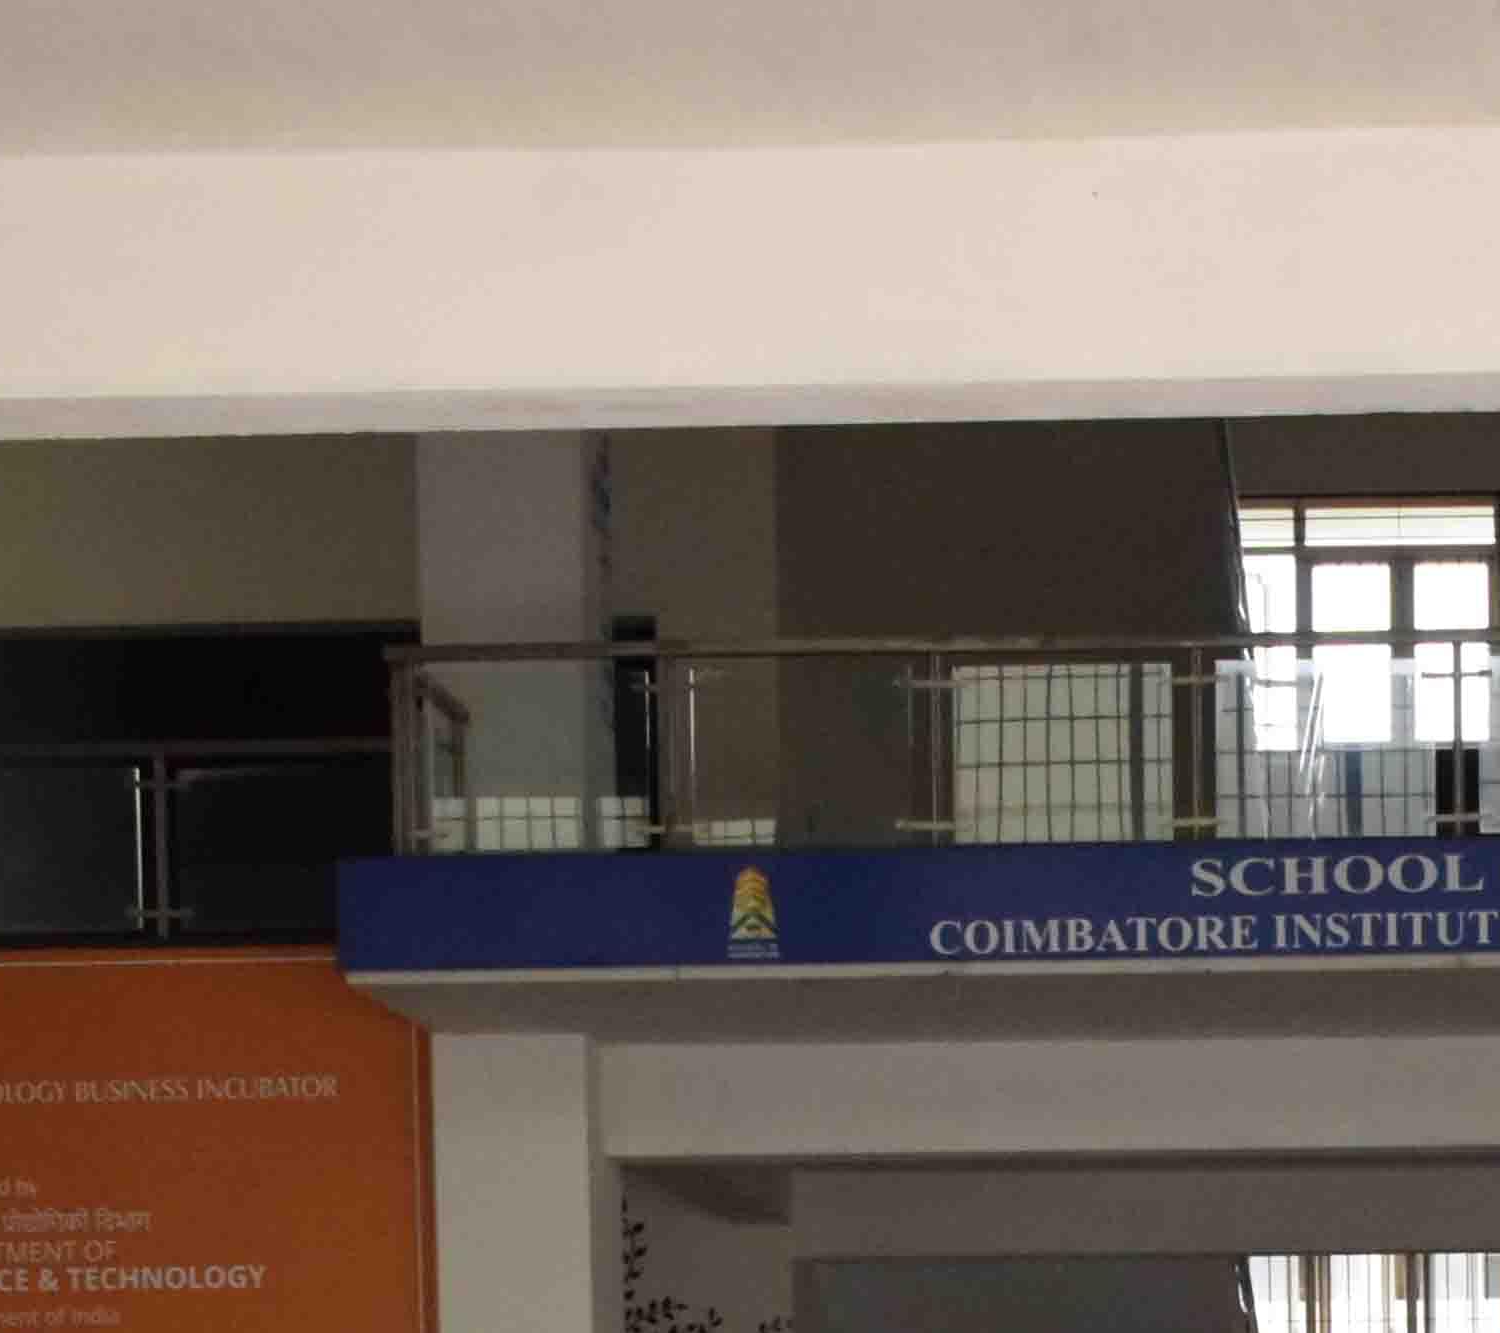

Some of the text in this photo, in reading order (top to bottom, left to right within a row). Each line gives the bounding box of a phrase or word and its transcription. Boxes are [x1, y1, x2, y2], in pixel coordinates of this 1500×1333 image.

[1190, 854, 1485, 898] SCHOOL
[929, 914, 1259, 954] COIMBATORE
[75, 1077, 189, 1103] BUSINESS
[196, 1074, 340, 1101] INCUBATOR
[83, 1238, 118, 1263] OF
[37, 1267, 60, 1293] &
[65, 1264, 269, 1291] TECHNOLOGY
[43, 1307, 66, 1327] of
[72, 1306, 122, 1327] India
